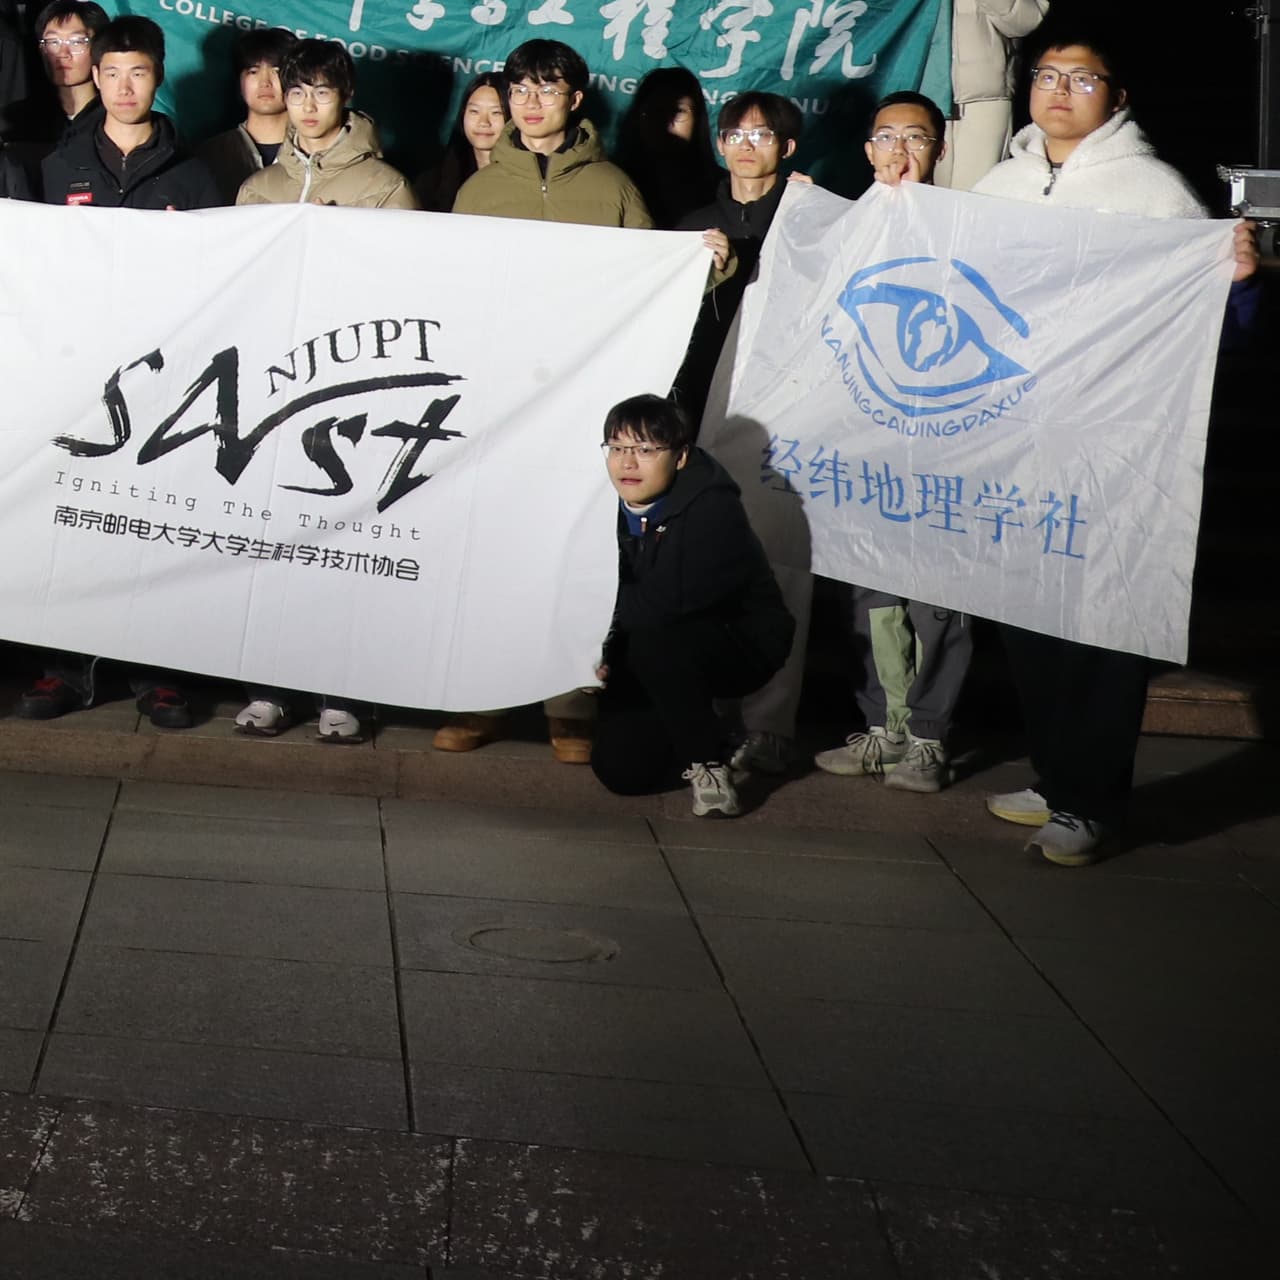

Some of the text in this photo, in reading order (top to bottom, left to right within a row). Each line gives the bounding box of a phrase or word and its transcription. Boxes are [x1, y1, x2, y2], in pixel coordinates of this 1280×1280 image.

[265, 316, 441, 397] NJUPT
[53, 470, 423, 542] Igniting The Thought
[760, 432, 1088, 561] 经纬地理学社
[52, 504, 421, 582] 南京邮电大学大学生科学技术协会
